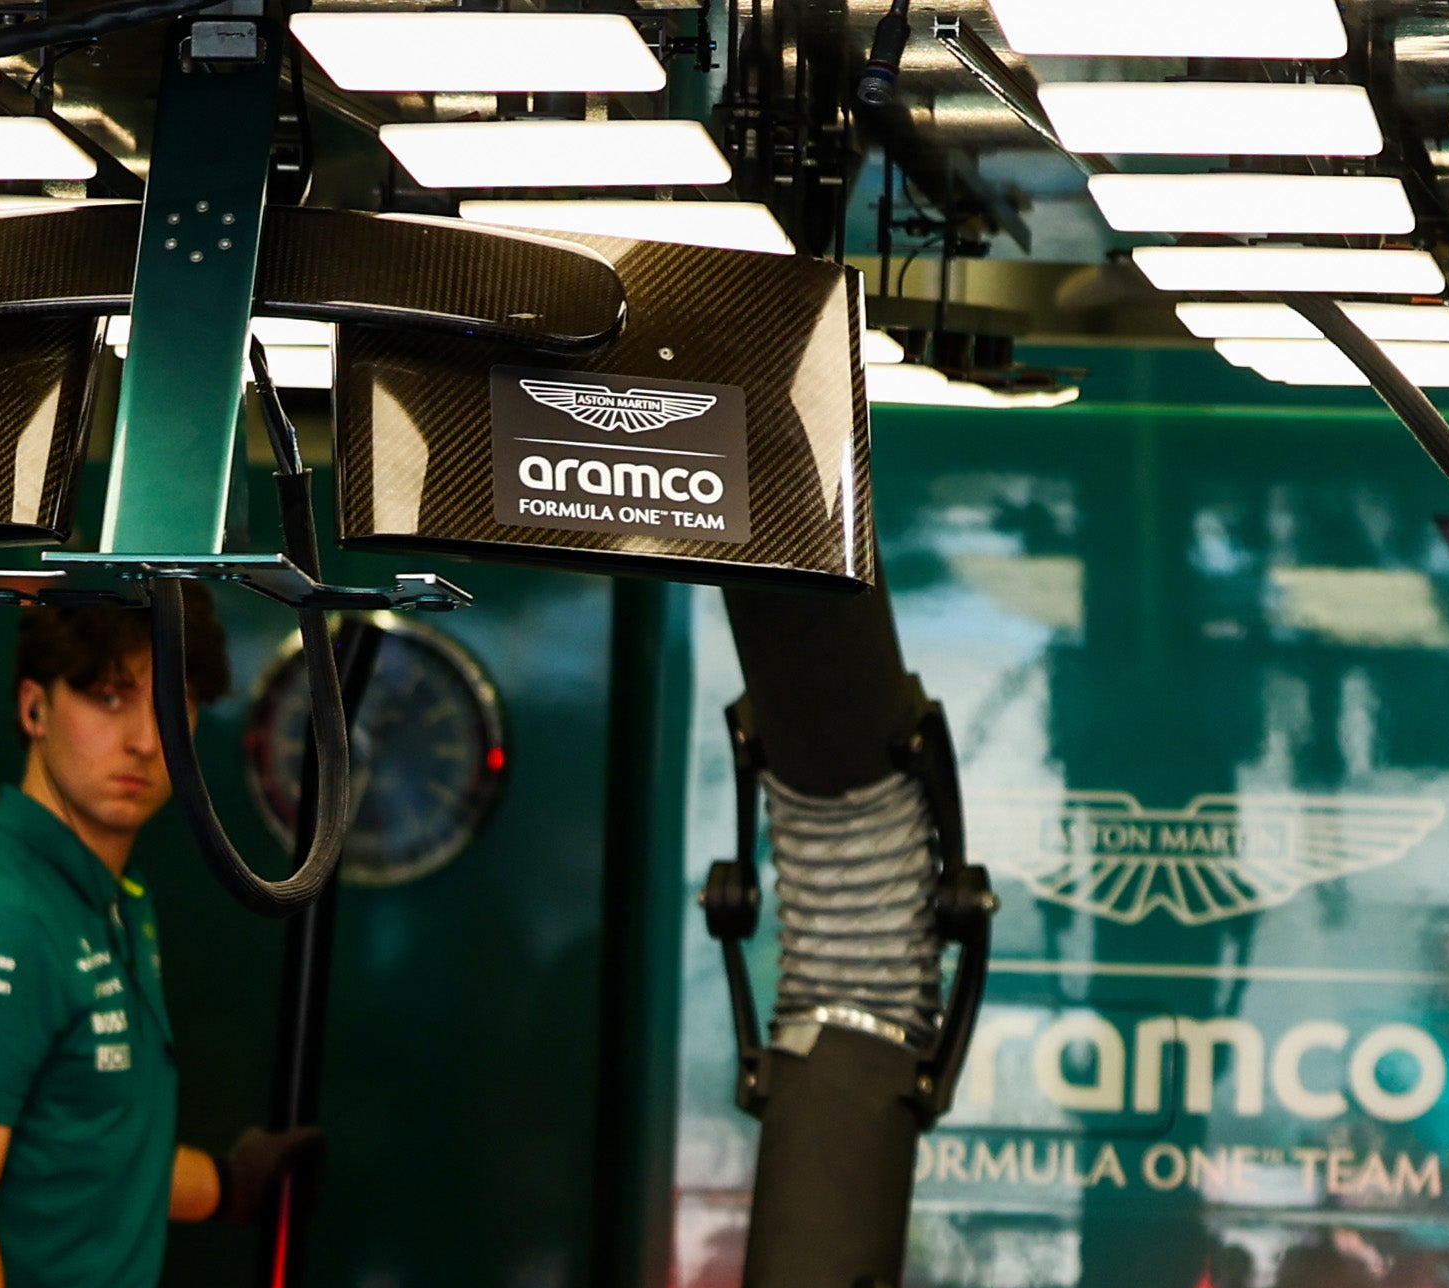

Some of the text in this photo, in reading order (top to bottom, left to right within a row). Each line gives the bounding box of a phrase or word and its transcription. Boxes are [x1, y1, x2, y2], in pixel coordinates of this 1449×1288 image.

[577, 394, 661, 411] ASTON MARTIN
[518, 455, 724, 505] aramco
[519, 498, 614, 521] FORMULA
[671, 511, 725, 530] TEAM
[970, 1010, 1447, 1123] ramco
[913, 1139, 1127, 1190] ORMULA
[1299, 1150, 1444, 1199] TEAM
